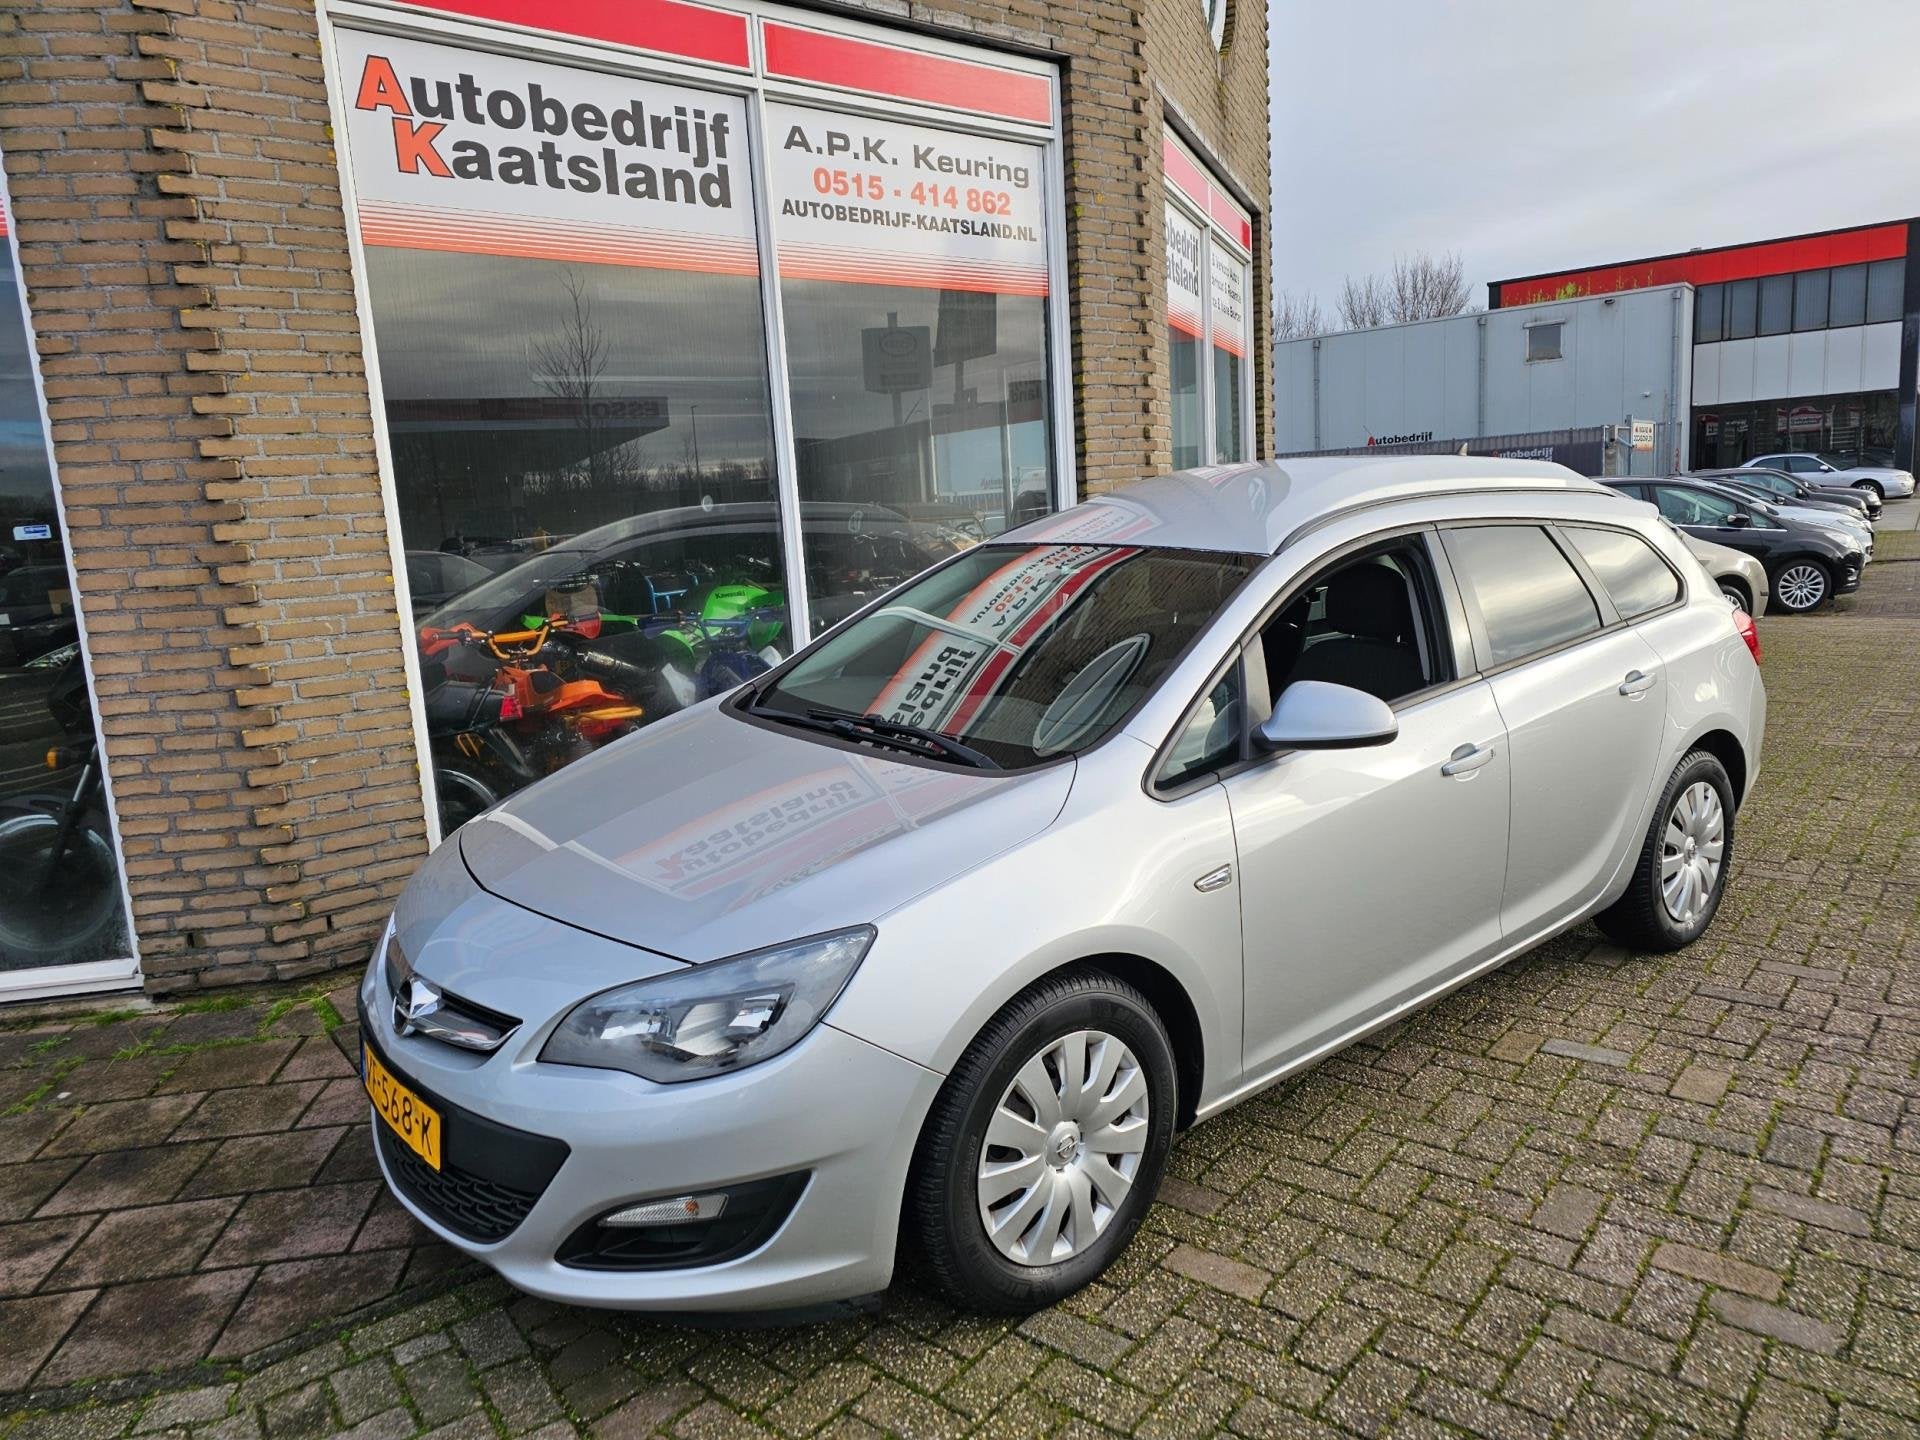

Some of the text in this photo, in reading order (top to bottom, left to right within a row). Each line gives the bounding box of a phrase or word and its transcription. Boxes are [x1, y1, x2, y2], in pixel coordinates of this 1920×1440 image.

[355, 54, 729, 168] Autobedrijf
[393, 117, 732, 208] Kaatsland
[783, 125, 1029, 188] A.P.K. Keuring
[813, 167, 884, 201] 0515
[910, 181, 959, 209] 414
[966, 188, 1012, 216] 862
[782, 198, 1038, 242] AUTOBEDRIJF-KAATSLAND.NL
[1367, 431, 1433, 446] Autobedrijf
